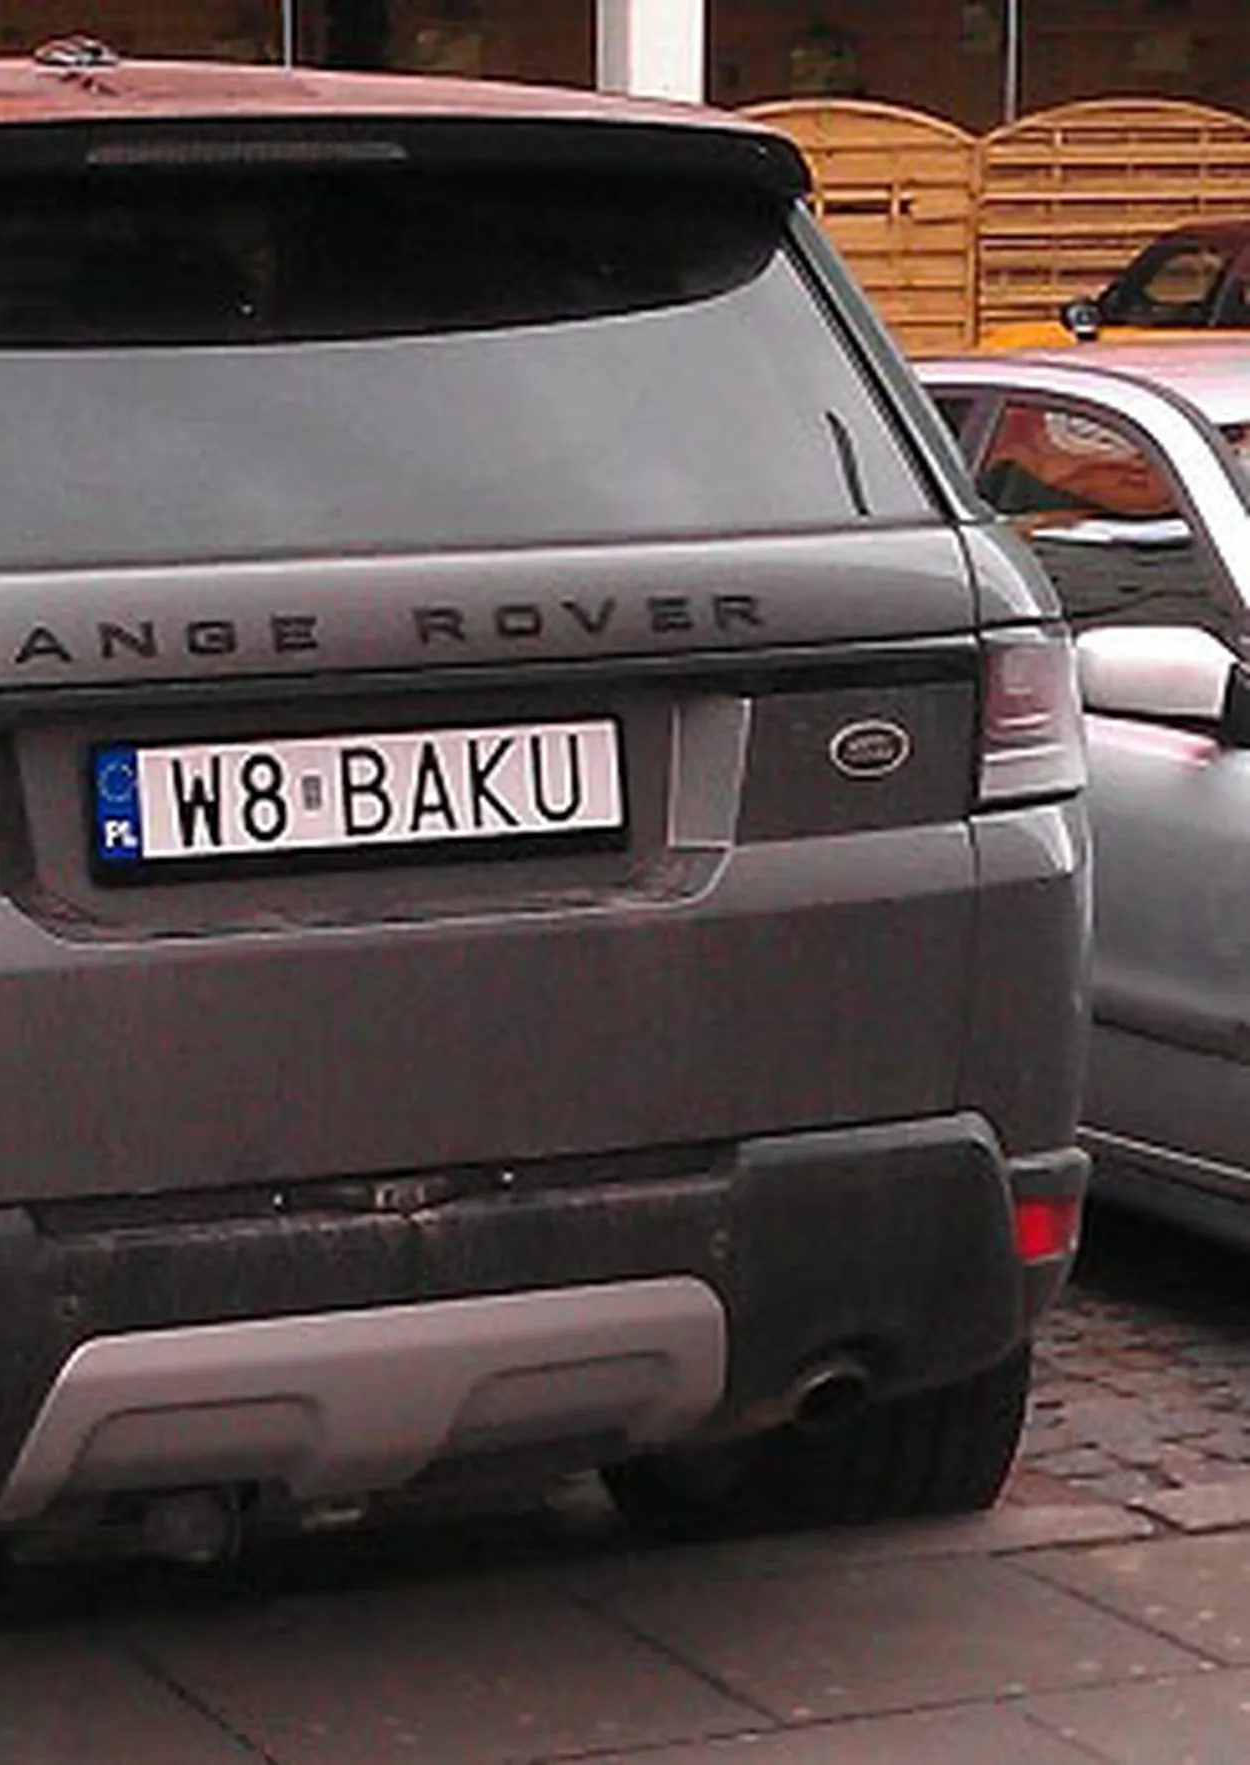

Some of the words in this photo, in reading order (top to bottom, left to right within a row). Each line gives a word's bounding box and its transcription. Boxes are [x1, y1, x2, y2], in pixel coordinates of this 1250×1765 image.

[412, 594, 764, 643] ROVER
[171, 754, 288, 847] W8
[342, 733, 582, 837] BAKU
[105, 820, 138, 848] PL
